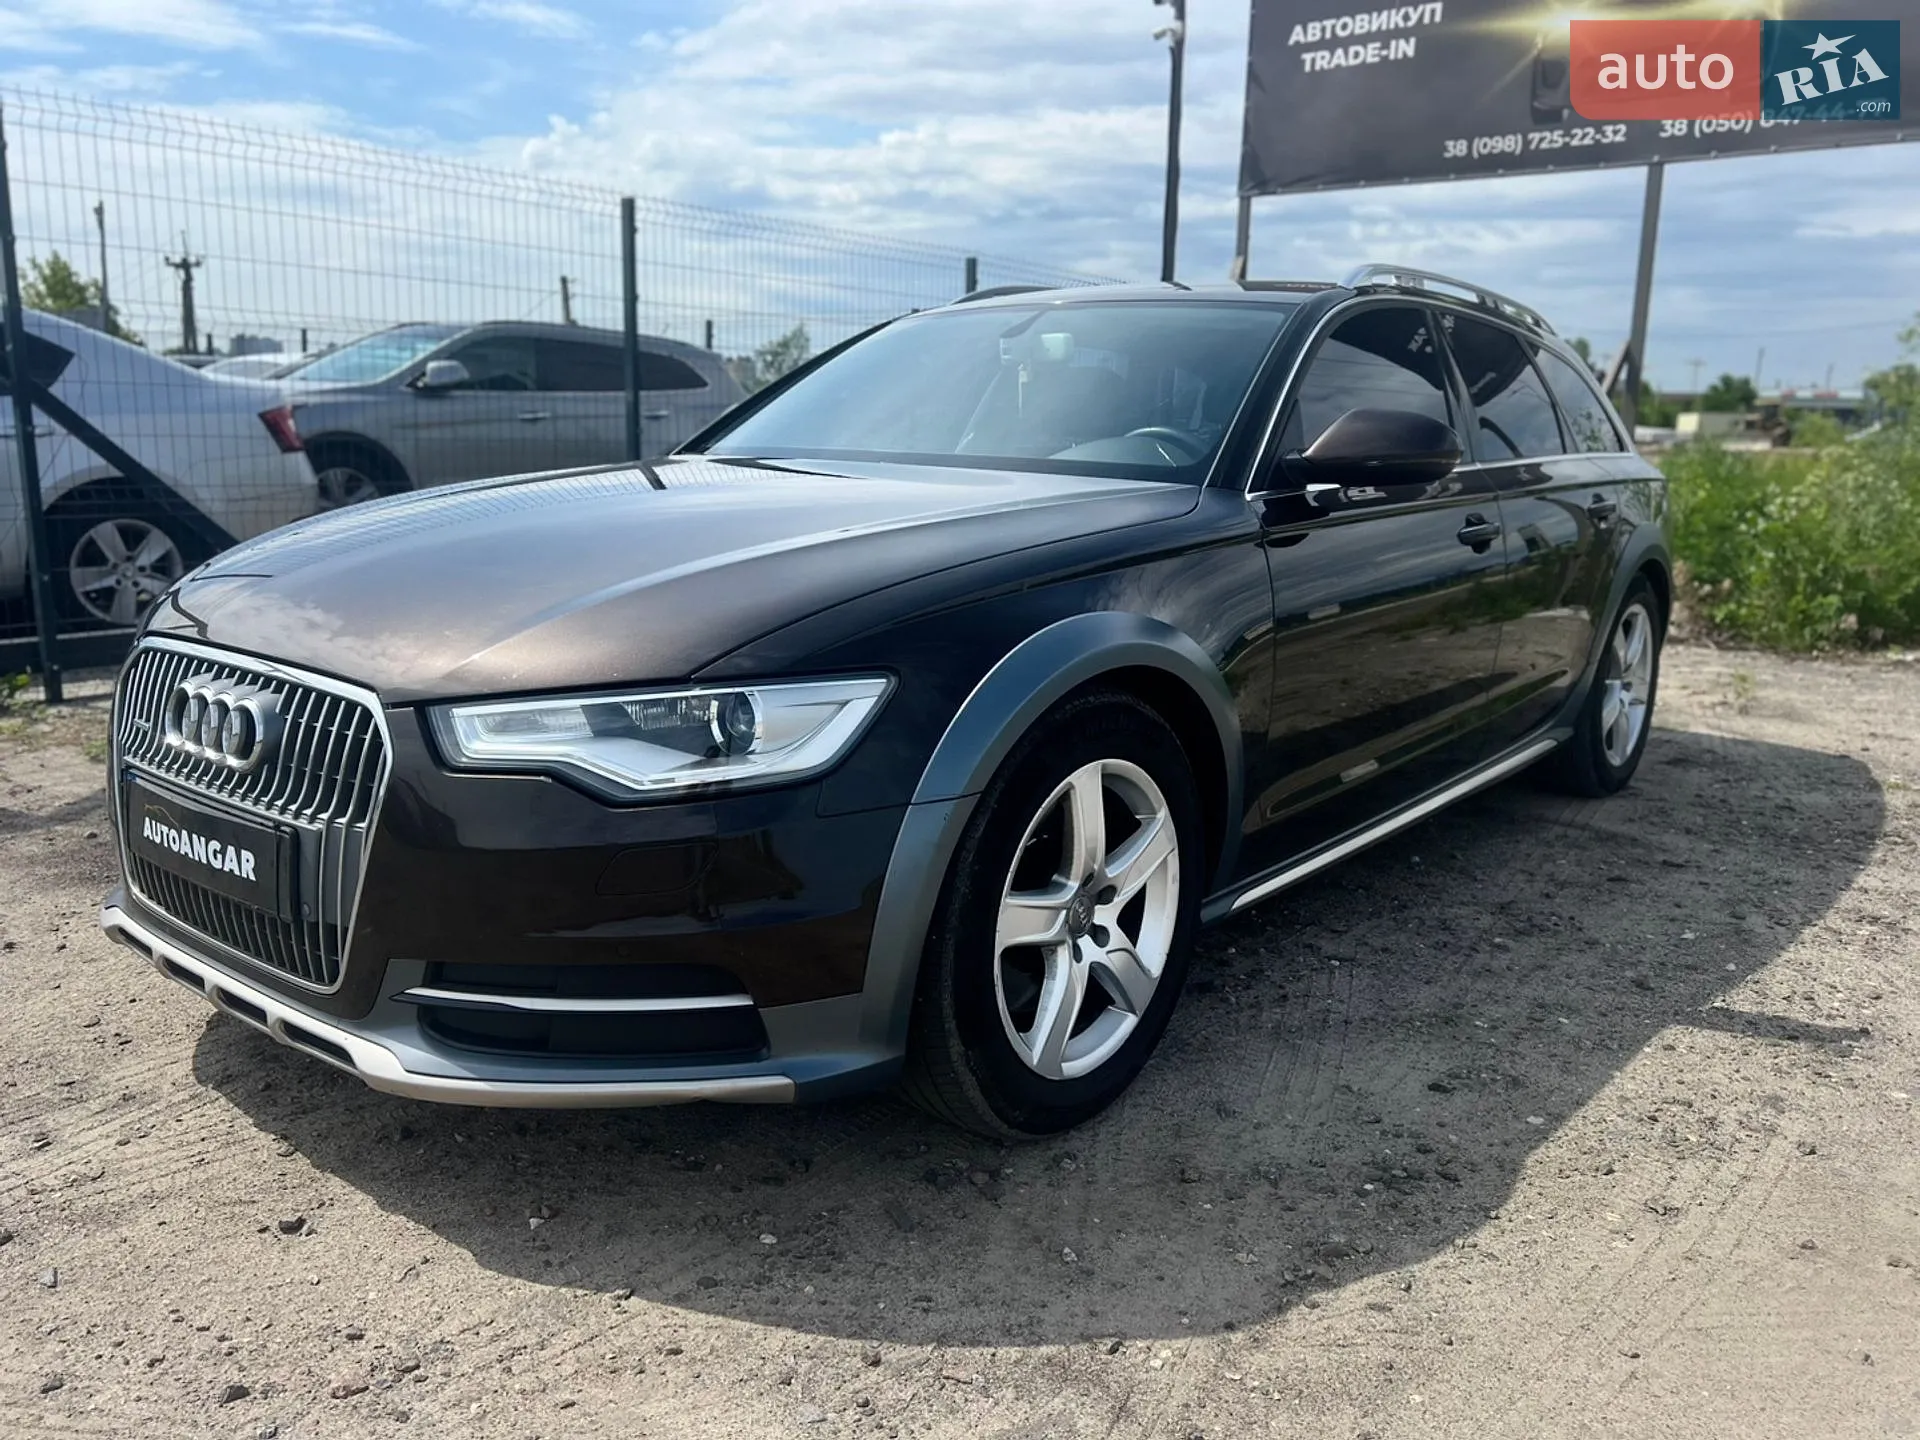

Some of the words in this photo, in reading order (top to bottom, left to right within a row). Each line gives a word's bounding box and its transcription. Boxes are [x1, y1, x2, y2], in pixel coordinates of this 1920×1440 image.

[1288, 2, 1443, 45] АВТОВИКУП
[1301, 37, 1416, 73] TRADE-IN
[1659, 116, 1688, 138] 38
[1694, 109, 1752, 138] (050)
[1443, 139, 1468, 158] 38
[1472, 133, 1522, 159] (098)
[1528, 124, 1627, 150] 725-22-32
